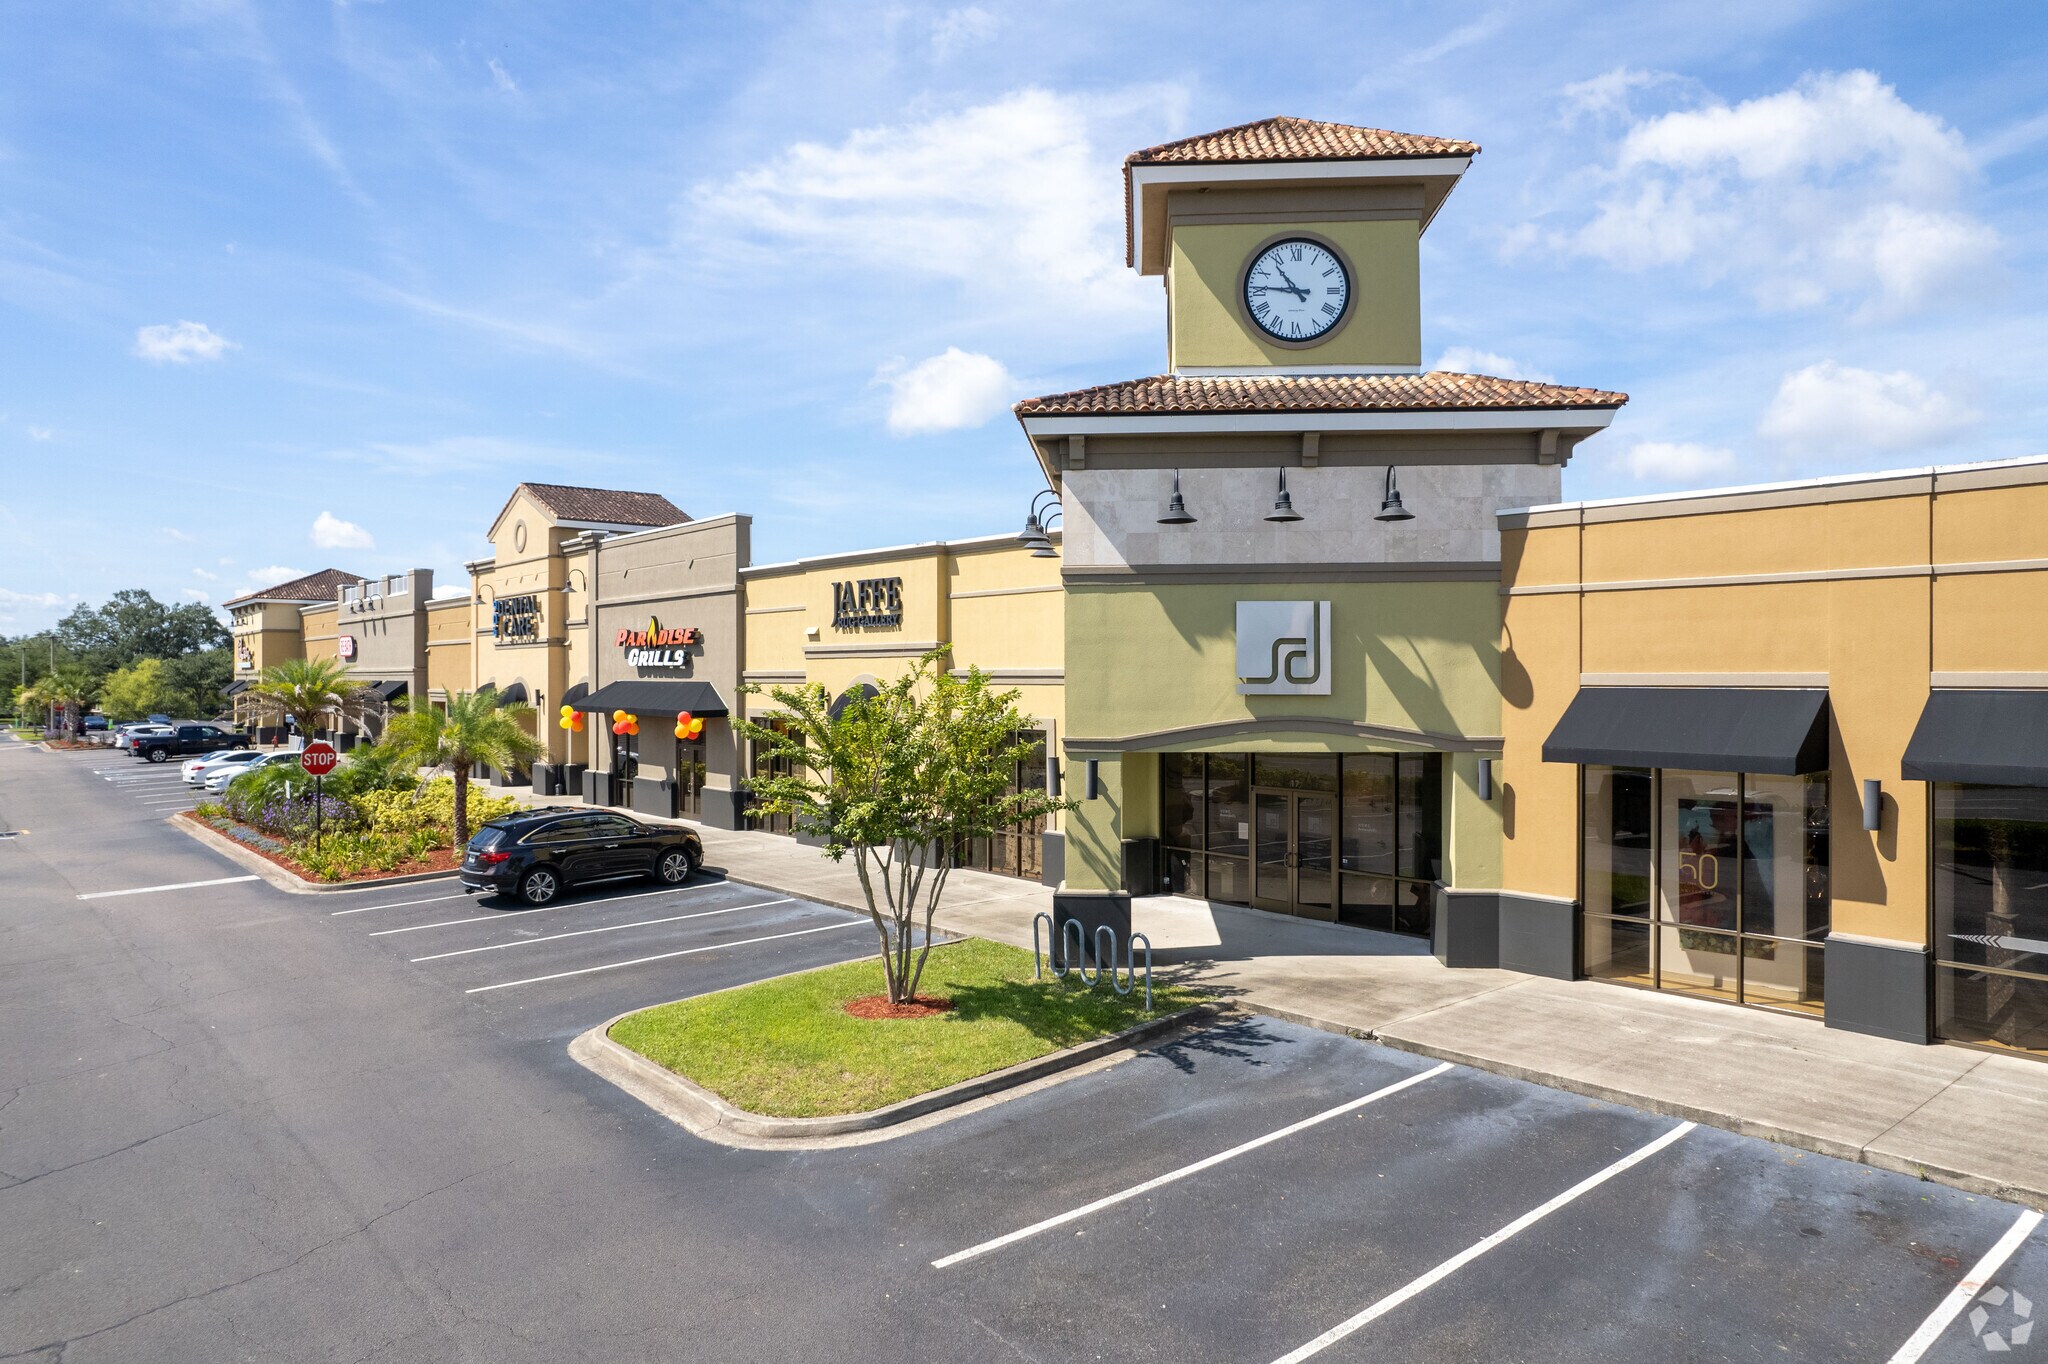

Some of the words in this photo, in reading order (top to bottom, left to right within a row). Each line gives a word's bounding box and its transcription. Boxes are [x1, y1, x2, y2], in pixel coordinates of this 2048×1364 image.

[1271, 253, 1284, 266] XI
[1290, 248, 1302, 261] XII
[1311, 253, 1319, 266] I
[1257, 268, 1271, 279] X
[1322, 268, 1335, 278] II
[1253, 286, 1266, 296] IX
[1327, 287, 1340, 295] III
[1256, 301, 1271, 319] VIII
[1270, 315, 1283, 331] VII
[1291, 321, 1301, 334] VI
[1312, 318, 1321, 330] V
[498, 595, 538, 616] DENTAL
[831, 577, 901, 627] JAFFE
[503, 615, 534, 637] CARE
[837, 616, 856, 628] RUG
[858, 614, 898, 627] GALLERY
[615, 622, 696, 647] PARADISE
[627, 648, 685, 667] GRILLS
[303, 752, 335, 766] STOP
[1679, 851, 1718, 890] 50
